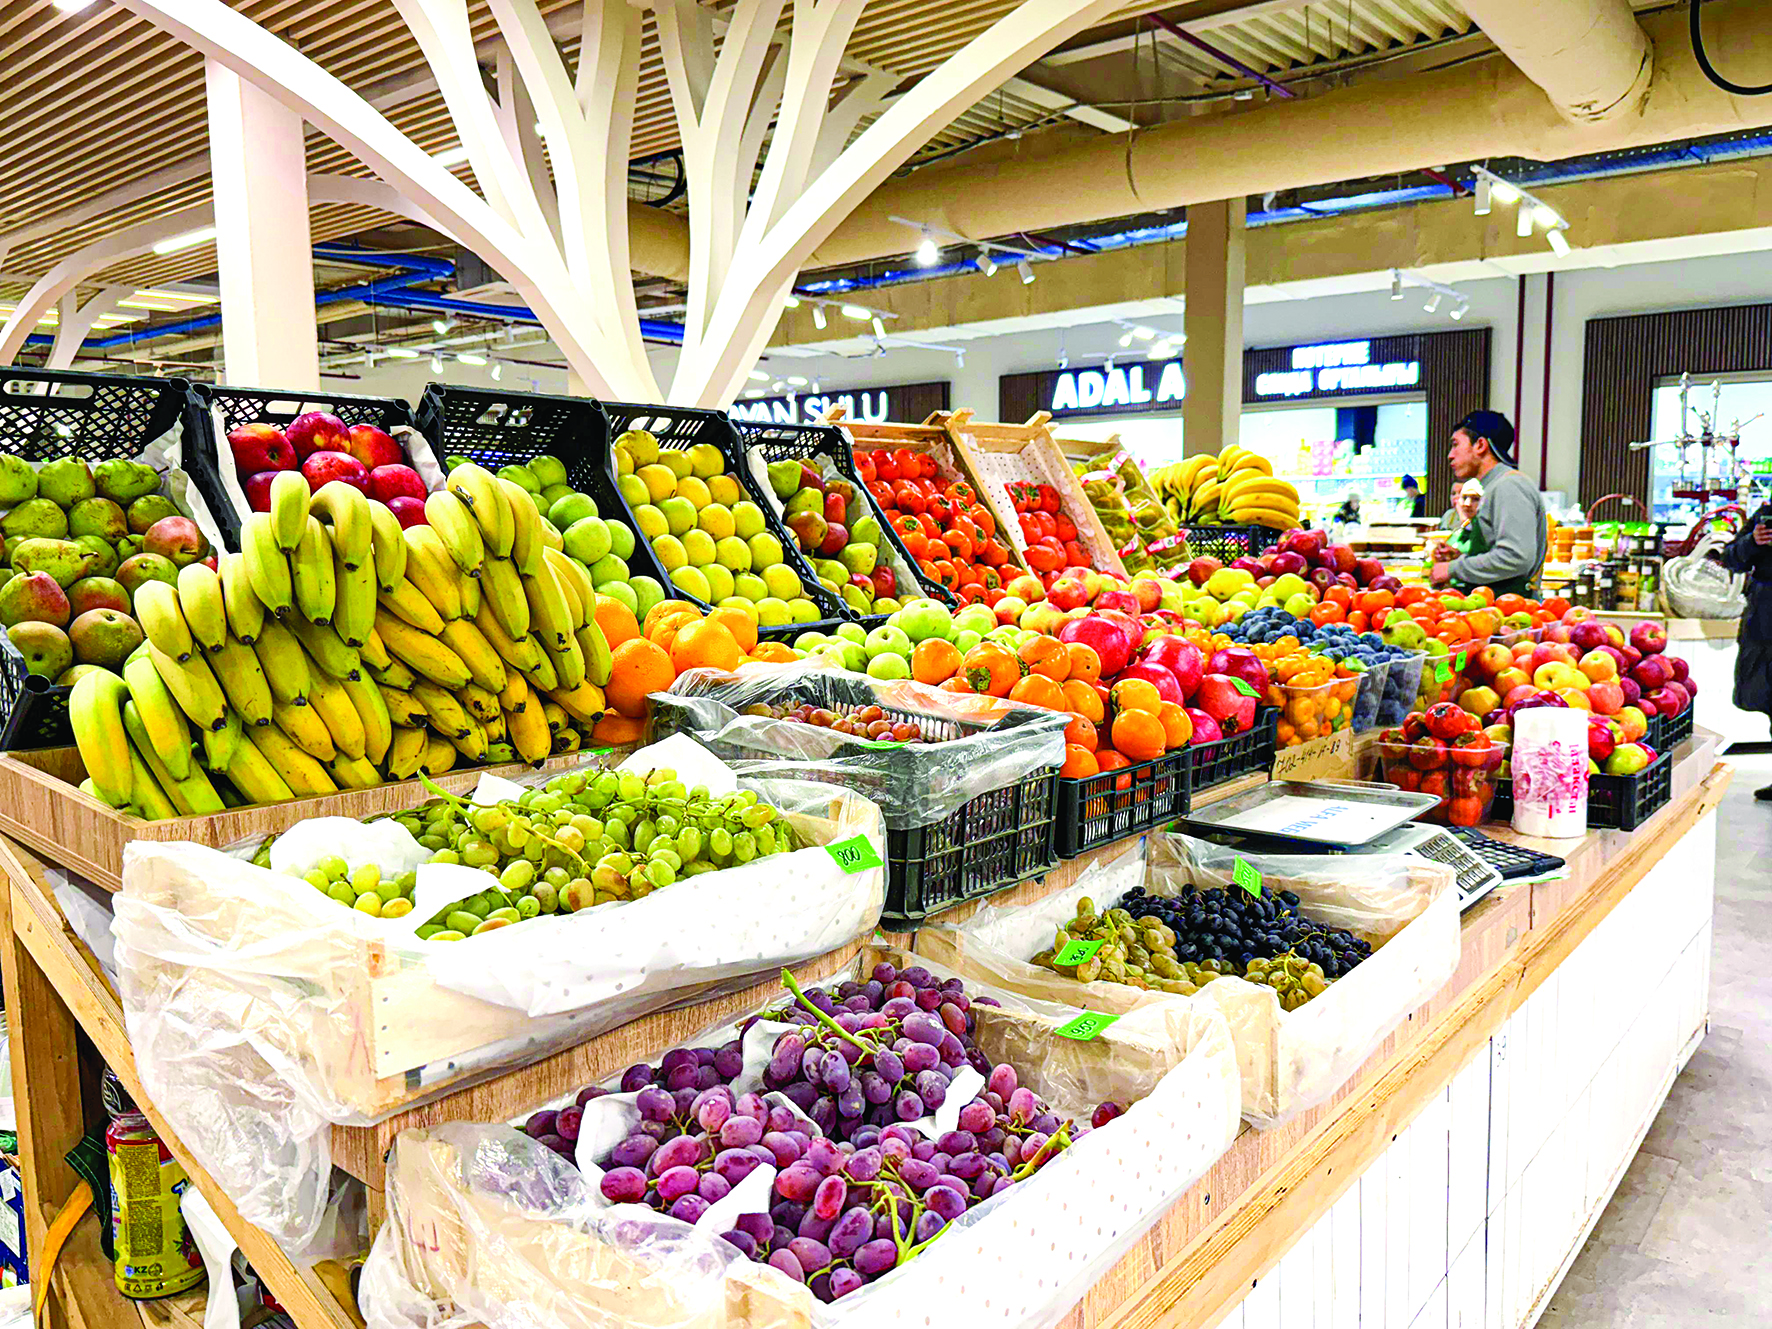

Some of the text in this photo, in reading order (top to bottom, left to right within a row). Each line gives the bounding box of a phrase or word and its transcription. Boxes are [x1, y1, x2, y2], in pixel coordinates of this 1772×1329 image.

[1051, 366, 1152, 410] ADAL
[1309, 805, 1349, 819] ALFA
[837, 845, 861, 866] 800
